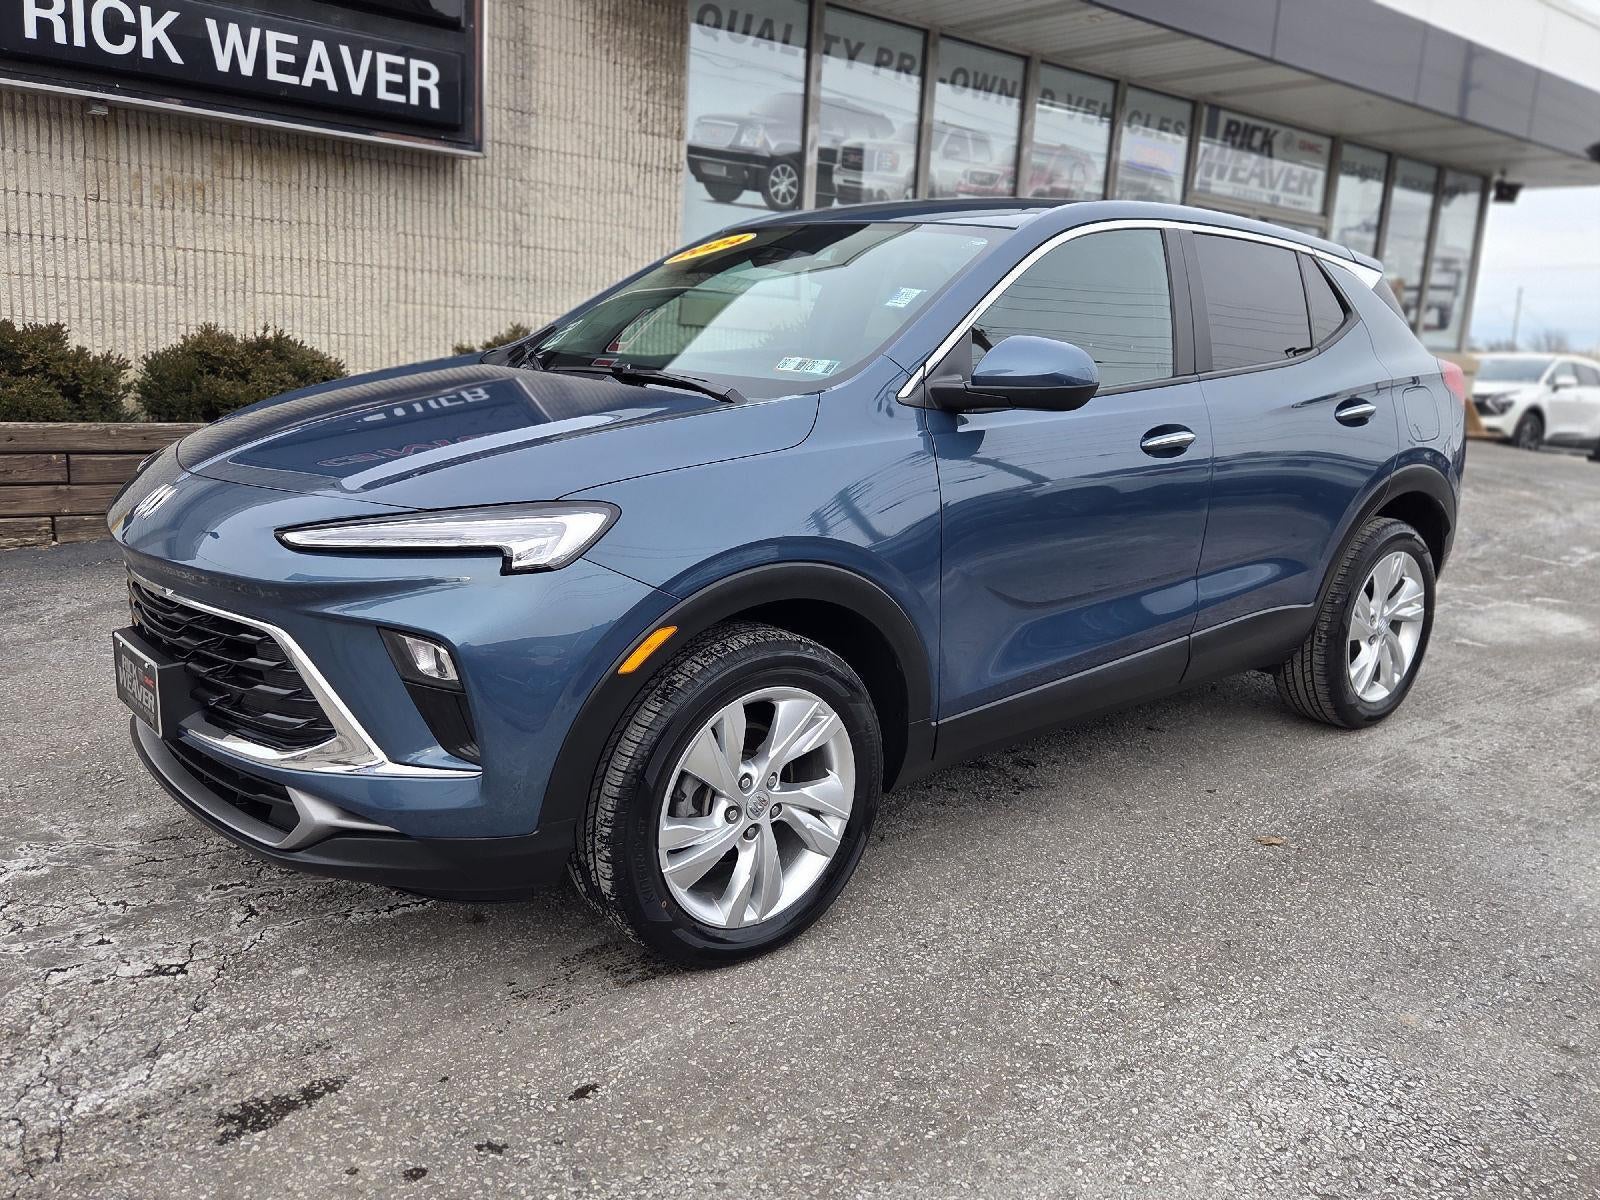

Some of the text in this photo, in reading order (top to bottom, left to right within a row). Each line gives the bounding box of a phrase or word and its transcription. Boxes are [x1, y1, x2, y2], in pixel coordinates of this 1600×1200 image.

[24, 0, 441, 109] RICK WEAVER
[696, 4, 865, 67] QUALTY
[1066, 92, 1187, 144] VEHCLES
[1223, 118, 1281, 158] RICK
[1202, 146, 1318, 197] WEAVER
[119, 665, 155, 713] WEAVER
